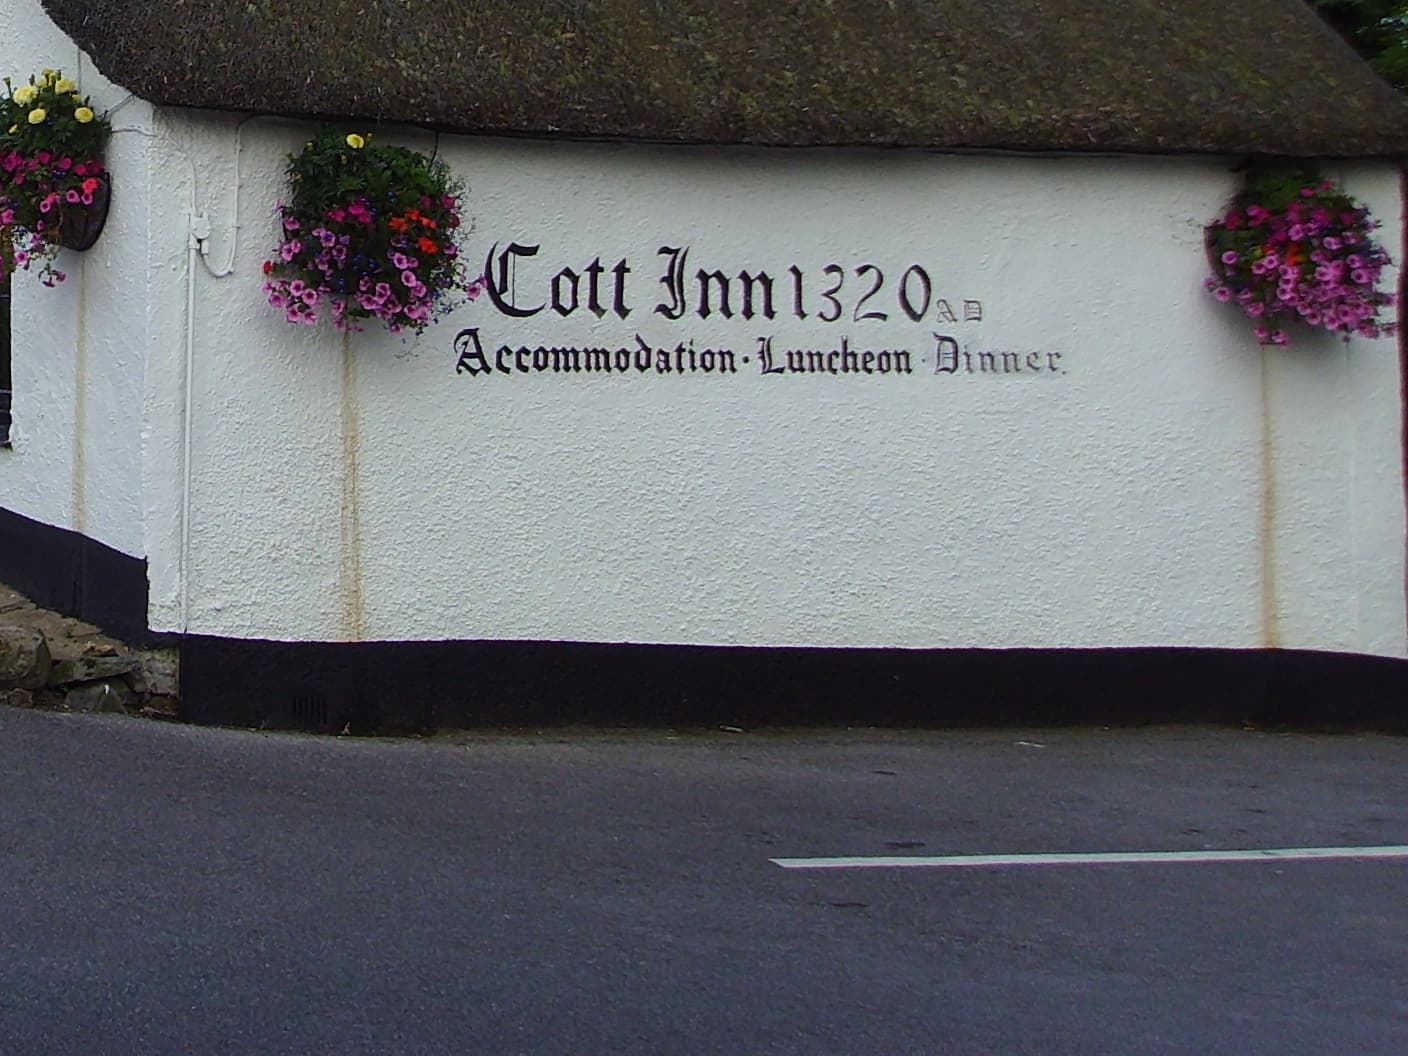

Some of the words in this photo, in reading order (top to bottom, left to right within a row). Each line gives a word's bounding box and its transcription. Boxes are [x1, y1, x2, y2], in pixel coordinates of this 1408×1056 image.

[484, 241, 633, 320] Cott
[653, 245, 777, 320] Inn
[788, 264, 932, 323] 1320
[756, 335, 913, 375] Luncheon
